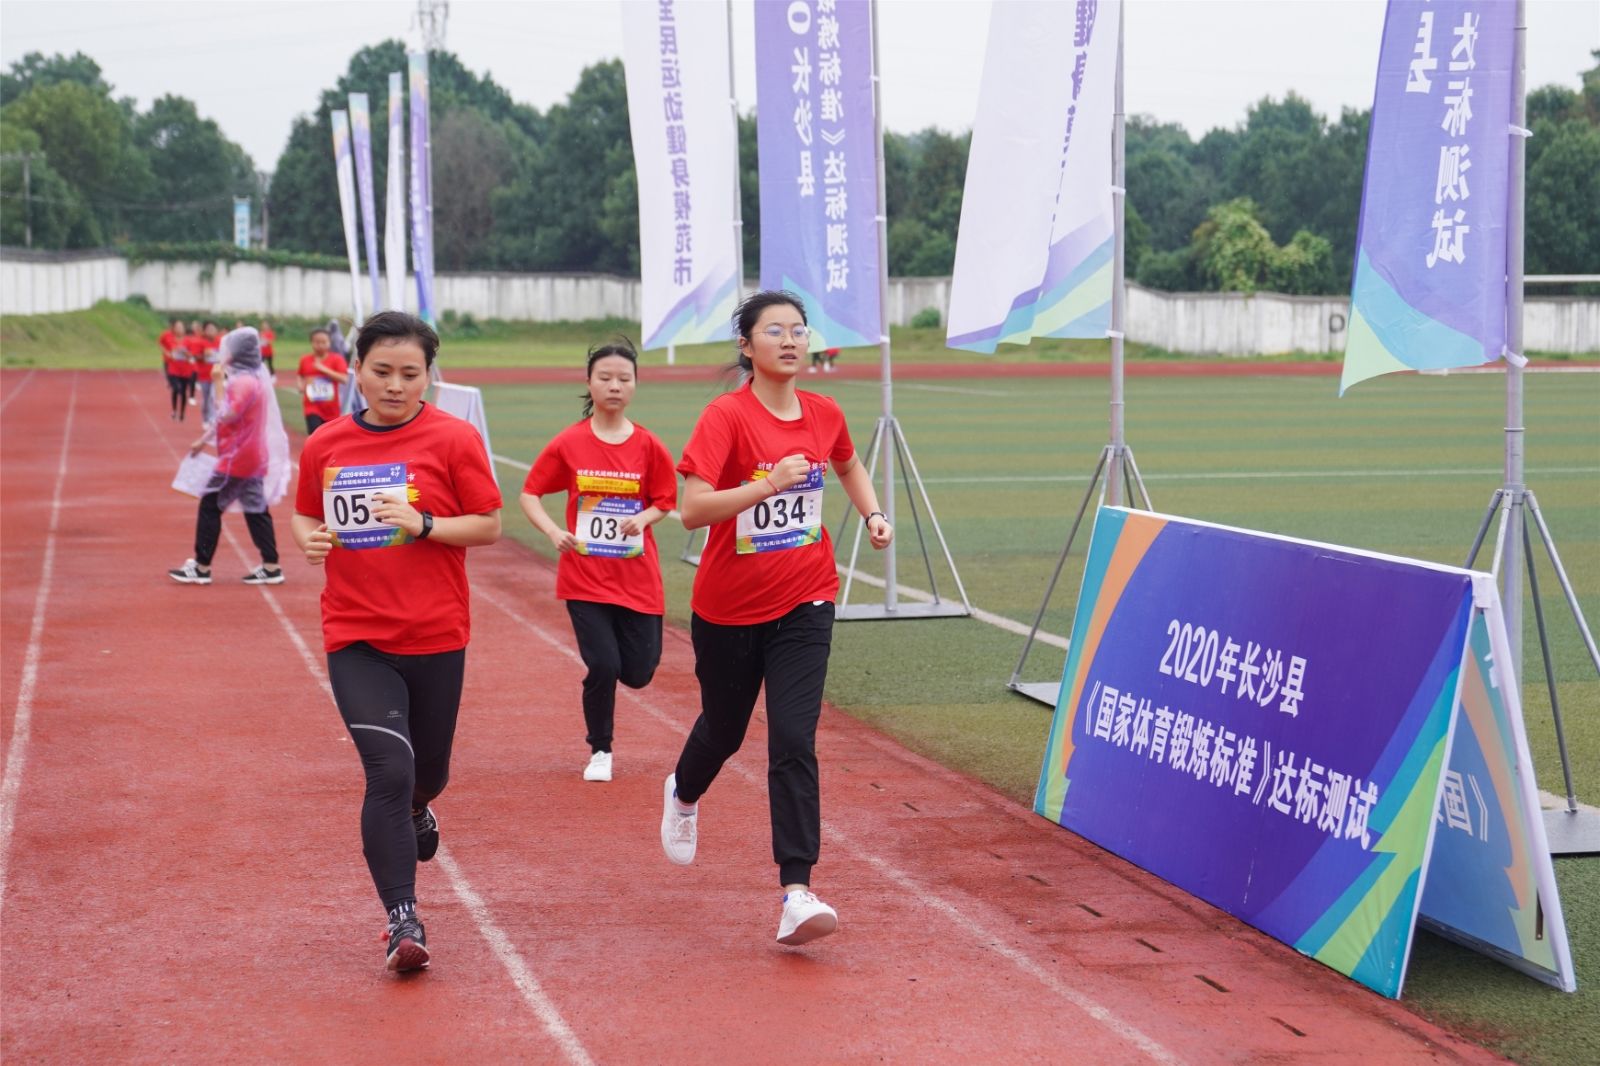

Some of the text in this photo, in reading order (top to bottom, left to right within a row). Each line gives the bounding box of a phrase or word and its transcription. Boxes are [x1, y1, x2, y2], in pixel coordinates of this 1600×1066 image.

[590, 516, 630, 542] 03
[754, 495, 806, 530] 034
[1159, 619, 1308, 718] 2020年长沙县
[1085, 680, 1379, 852] 《国家体育锻炼标准》达标测试
